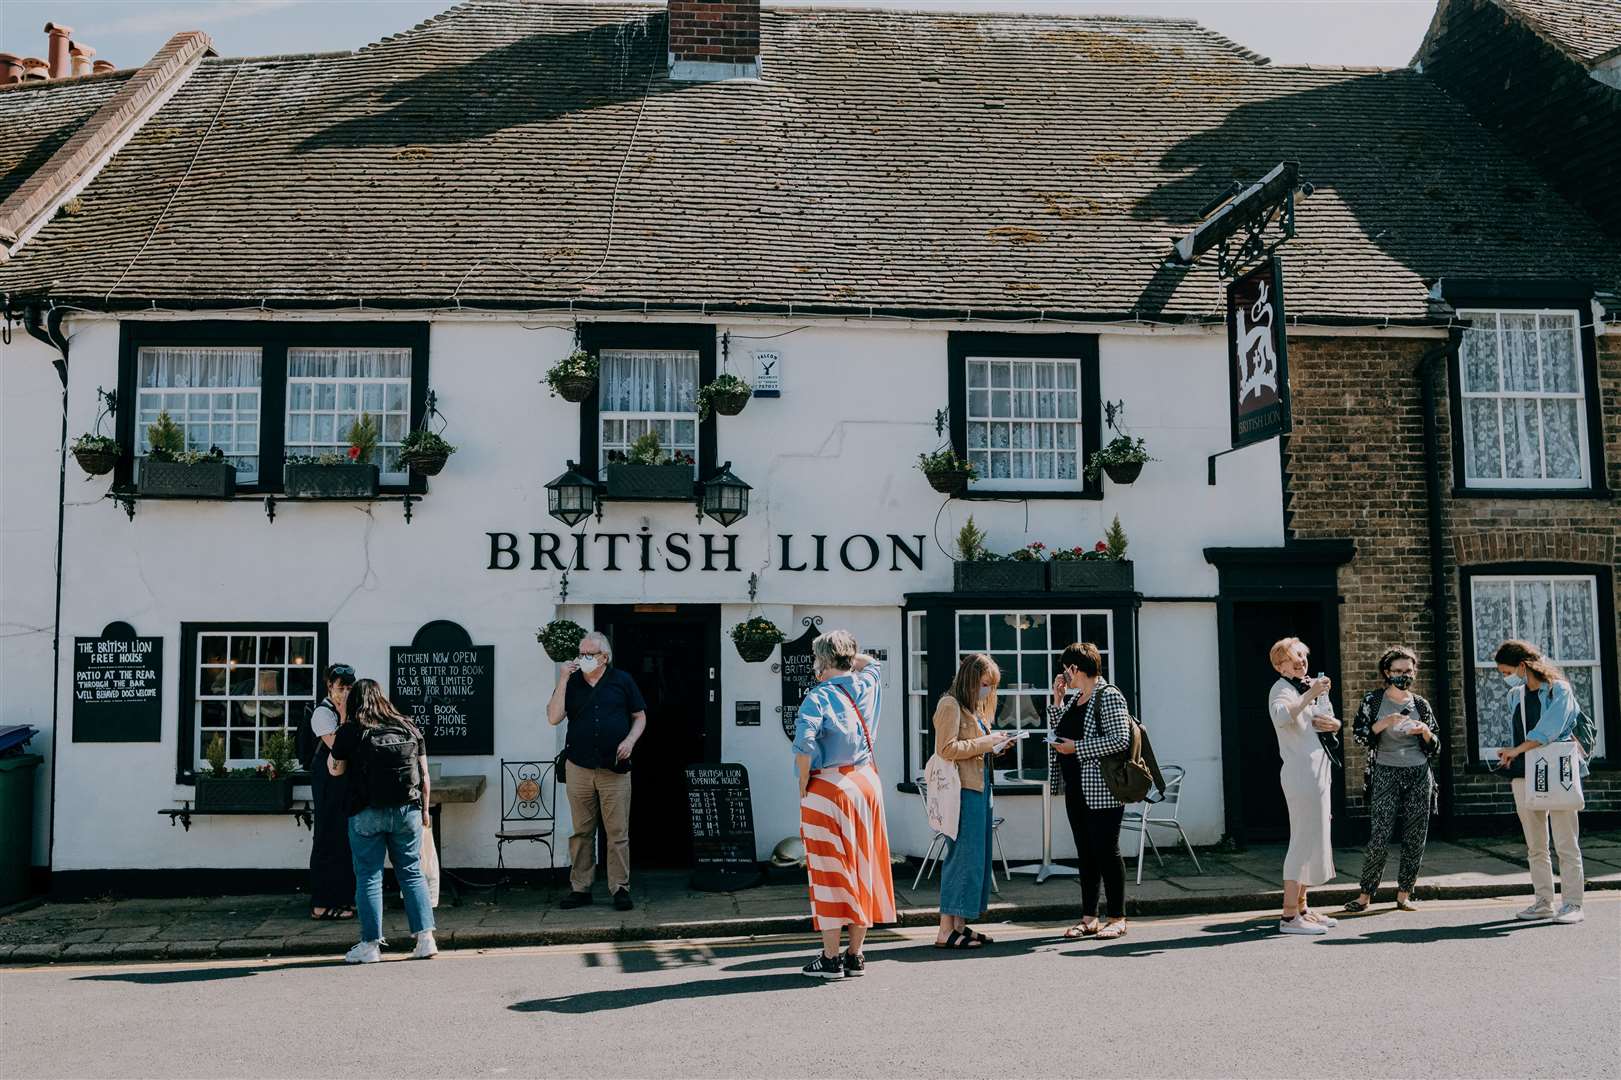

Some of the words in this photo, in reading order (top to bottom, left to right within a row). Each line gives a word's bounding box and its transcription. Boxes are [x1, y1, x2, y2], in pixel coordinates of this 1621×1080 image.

[1238, 415, 1264, 434] BRITISH
[1264, 410, 1281, 426] LION
[486, 532, 741, 572] BRITISH
[777, 534, 927, 572] LION
[77, 642, 93, 653] THE
[97, 640, 128, 653] BRITISH
[132, 640, 152, 653] LION
[91, 654, 114, 663] FREE
[119, 653, 143, 662] HOUSE
[397, 653, 429, 664] KITCHEN
[432, 652, 450, 663] NOW
[452, 652, 477, 663] OPEN
[76, 671, 101, 681] PATIO
[104, 671, 115, 680] AT
[119, 671, 133, 680] THE
[135, 670, 156, 680] REAR
[397, 667, 406, 676] IT
[409, 667, 416, 676] IS
[420, 666, 447, 676] BETTER
[449, 666, 459, 676] TO
[462, 666, 484, 676] BOOK
[78, 680, 108, 689] THROUGH
[397, 677, 406, 686] AS
[410, 677, 420, 686] WE
[423, 676, 438, 686] HAVE
[441, 676, 474, 686] LIMITED
[76, 690, 93, 700] WELL
[96, 690, 120, 699] BEHAVED
[122, 689, 135, 698] DOGS
[136, 689, 156, 697] WELCOME
[397, 686, 422, 696] TABLES
[426, 686, 440, 696] FOR
[444, 686, 475, 696] DINING
[798, 688, 810, 699] 14
[412, 705, 426, 714] TO
[434, 705, 458, 714] BOOK
[437, 714, 467, 725] PHONE
[434, 727, 467, 736] 251478
[684, 770, 696, 778] THE
[698, 770, 724, 778] BRITISH
[691, 777, 719, 785] OPENING
